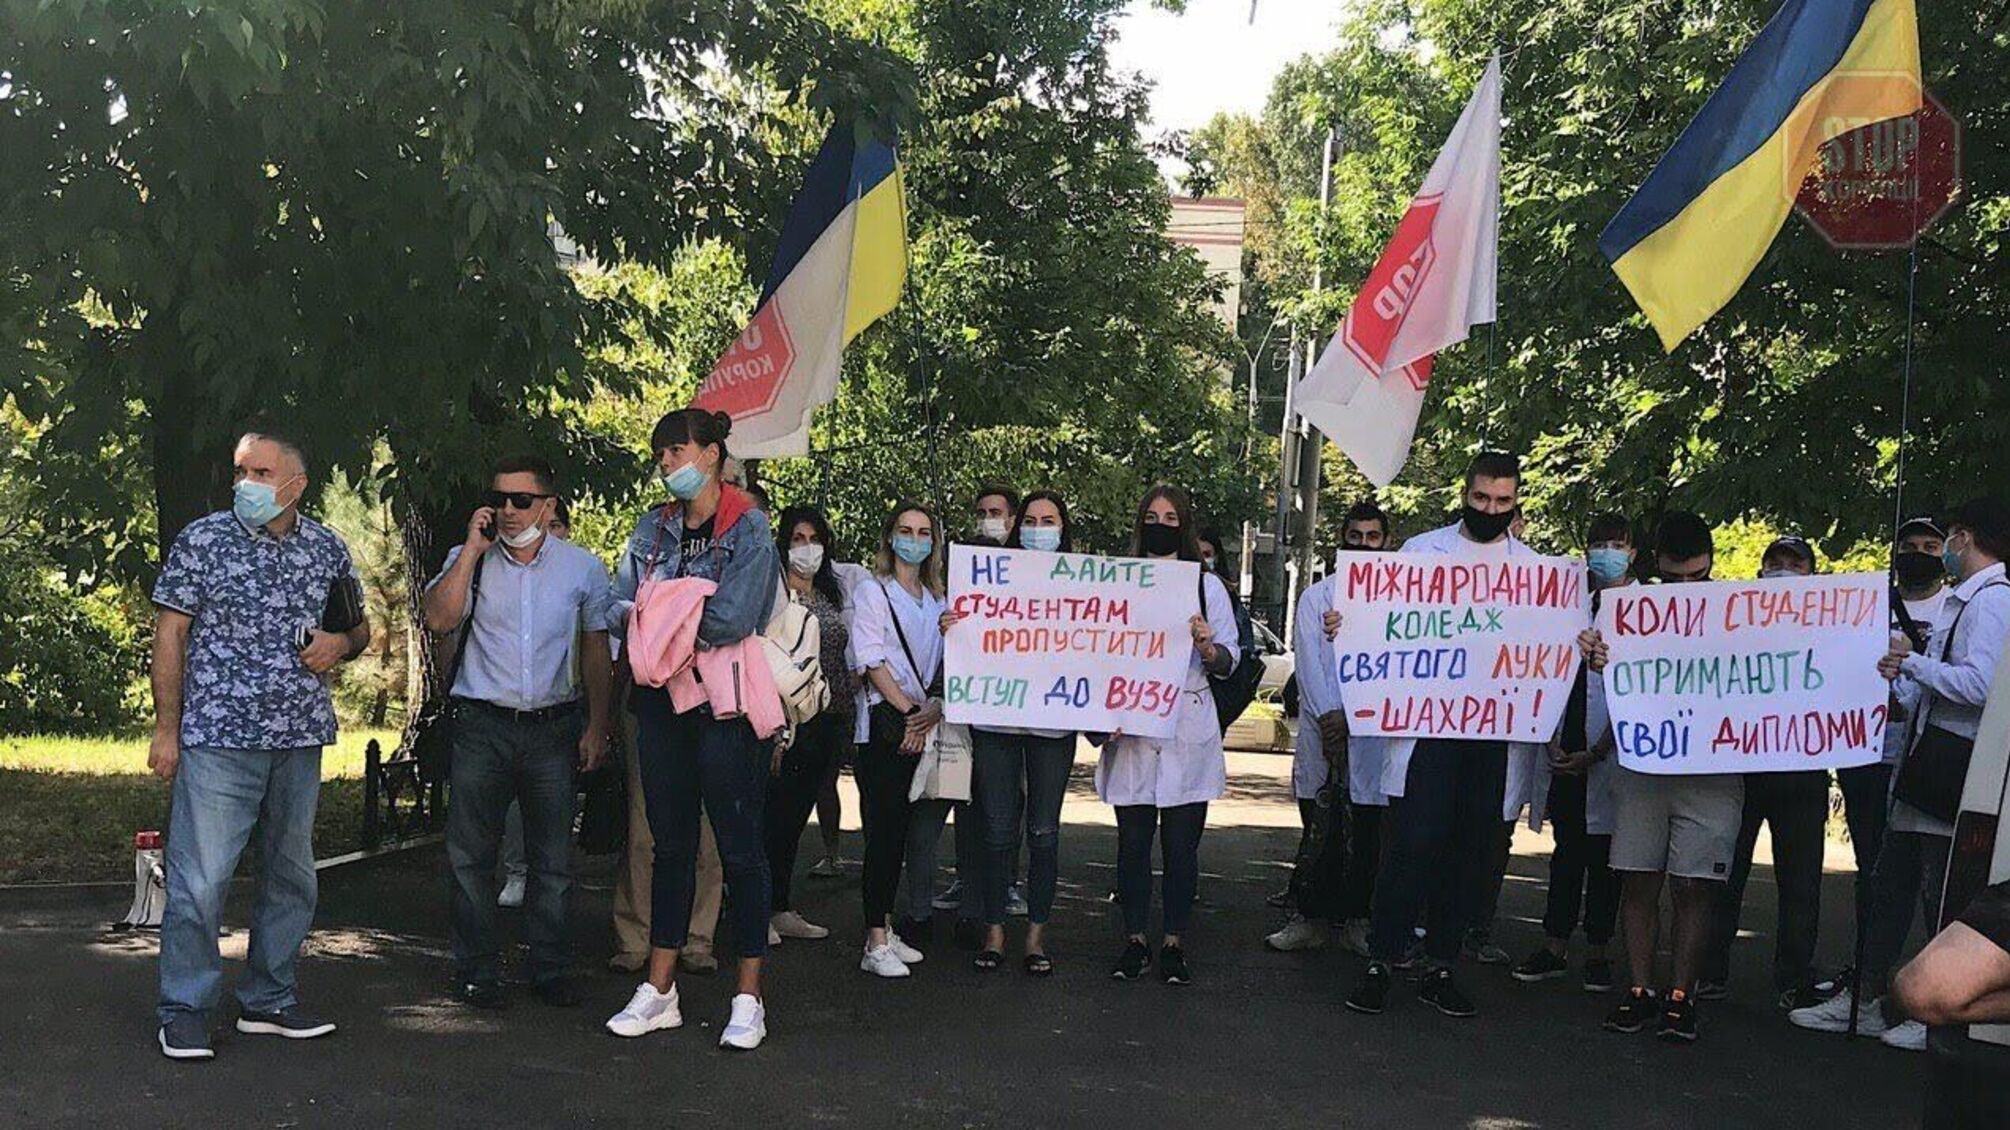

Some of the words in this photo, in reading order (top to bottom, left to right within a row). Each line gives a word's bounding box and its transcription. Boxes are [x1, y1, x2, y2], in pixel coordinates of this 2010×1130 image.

[971, 554, 1012, 585] НЕ
[1050, 555, 1156, 588] ДАЙТЕ
[953, 593, 1129, 625] СТУДЕНТАМ
[1385, 606, 1504, 642] КОЛЕДЖ
[1615, 596, 1707, 638] КОЛИ
[1723, 588, 1878, 633] СТУДЕНТИ
[982, 628, 1166, 658] ПРОПУСТИТИ
[1339, 648, 1467, 684] СВЯТОГО
[1491, 643, 1574, 681] ЛУКИ
[1613, 648, 1825, 700] ОТРИМАЮТЬ
[947, 675, 1029, 709] ВСТУП
[1044, 676, 1090, 708] ДО
[1104, 676, 1181, 717] ВУЗУ
[1616, 708, 1694, 760] СВОЇ
[1711, 703, 1888, 757] ДИПЛОМИ?
